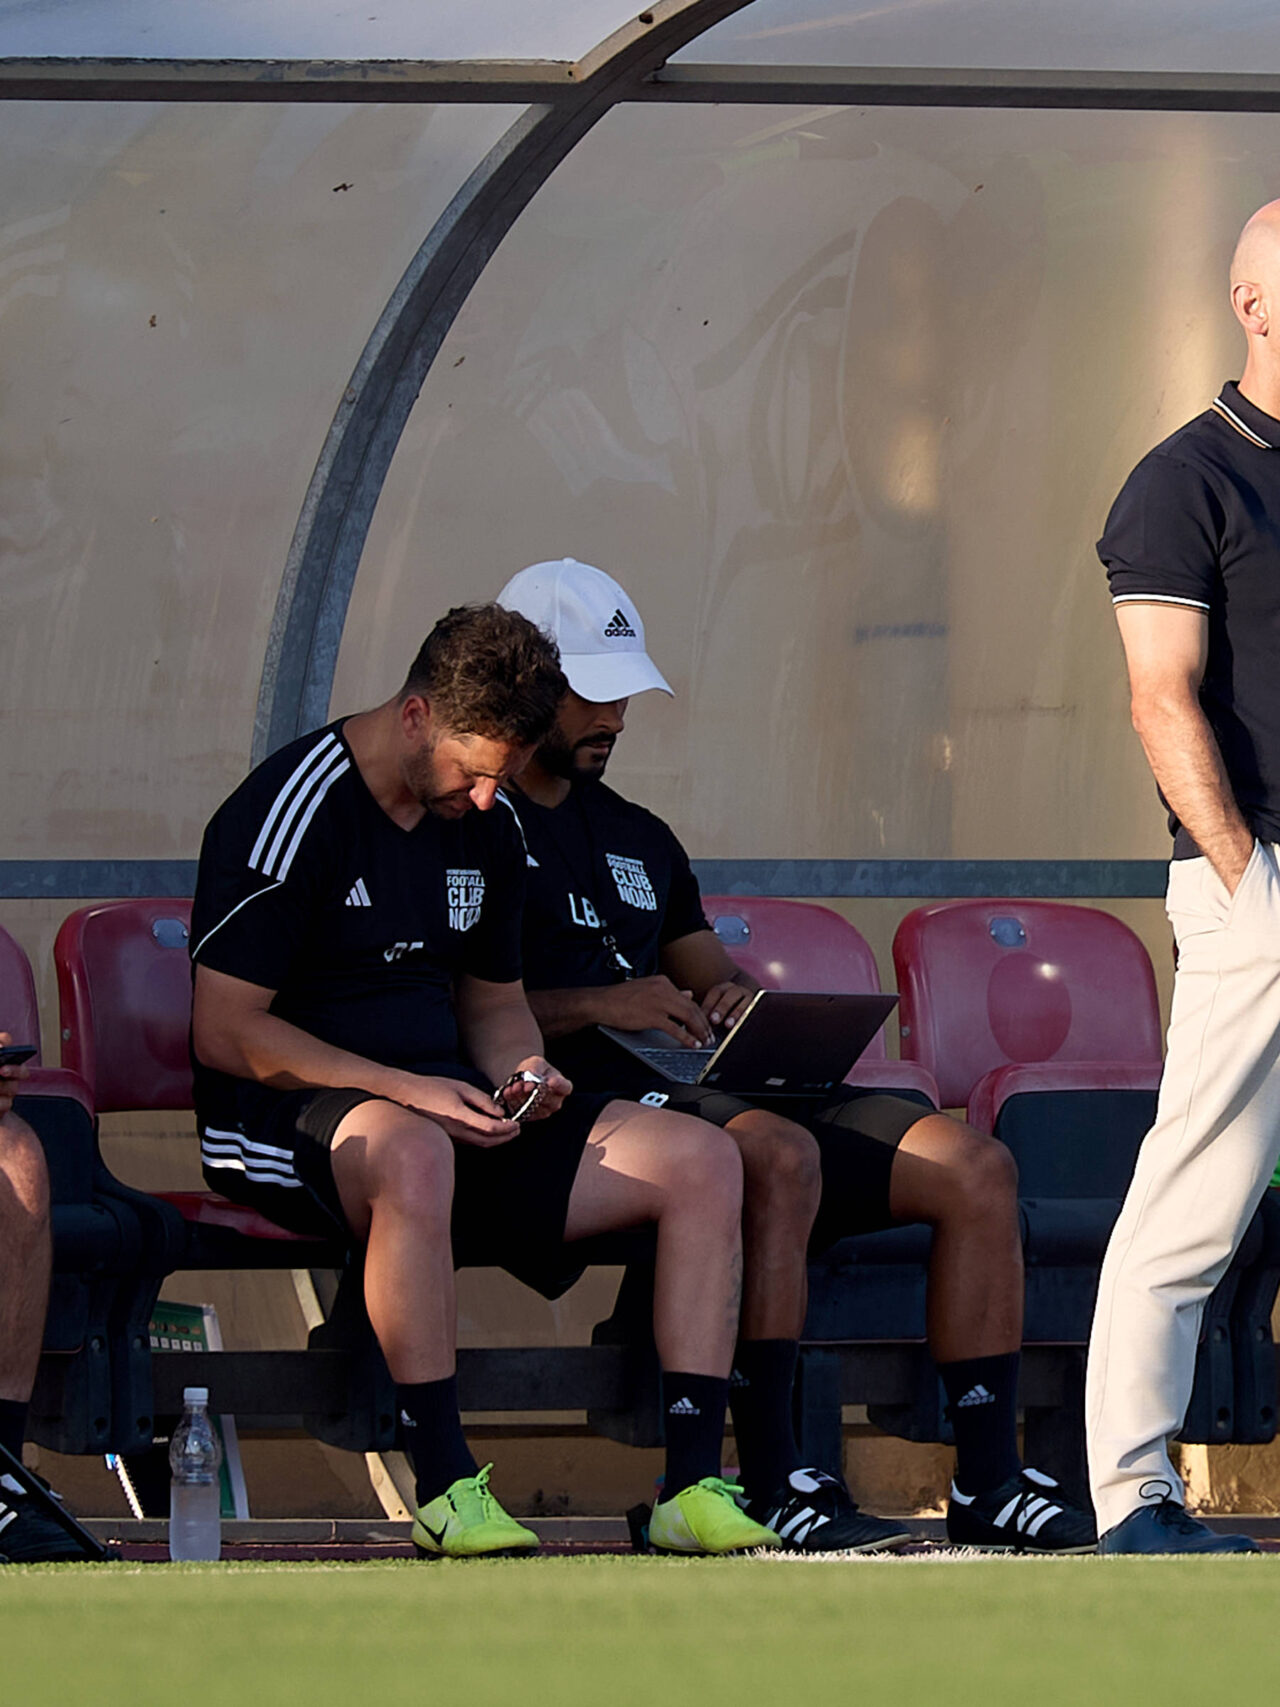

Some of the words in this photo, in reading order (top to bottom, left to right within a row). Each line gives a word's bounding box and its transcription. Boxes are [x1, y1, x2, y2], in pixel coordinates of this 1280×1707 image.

[604, 627, 636, 638] adidas
[612, 868, 653, 892] CLUB
[617, 884, 657, 911] NOAH
